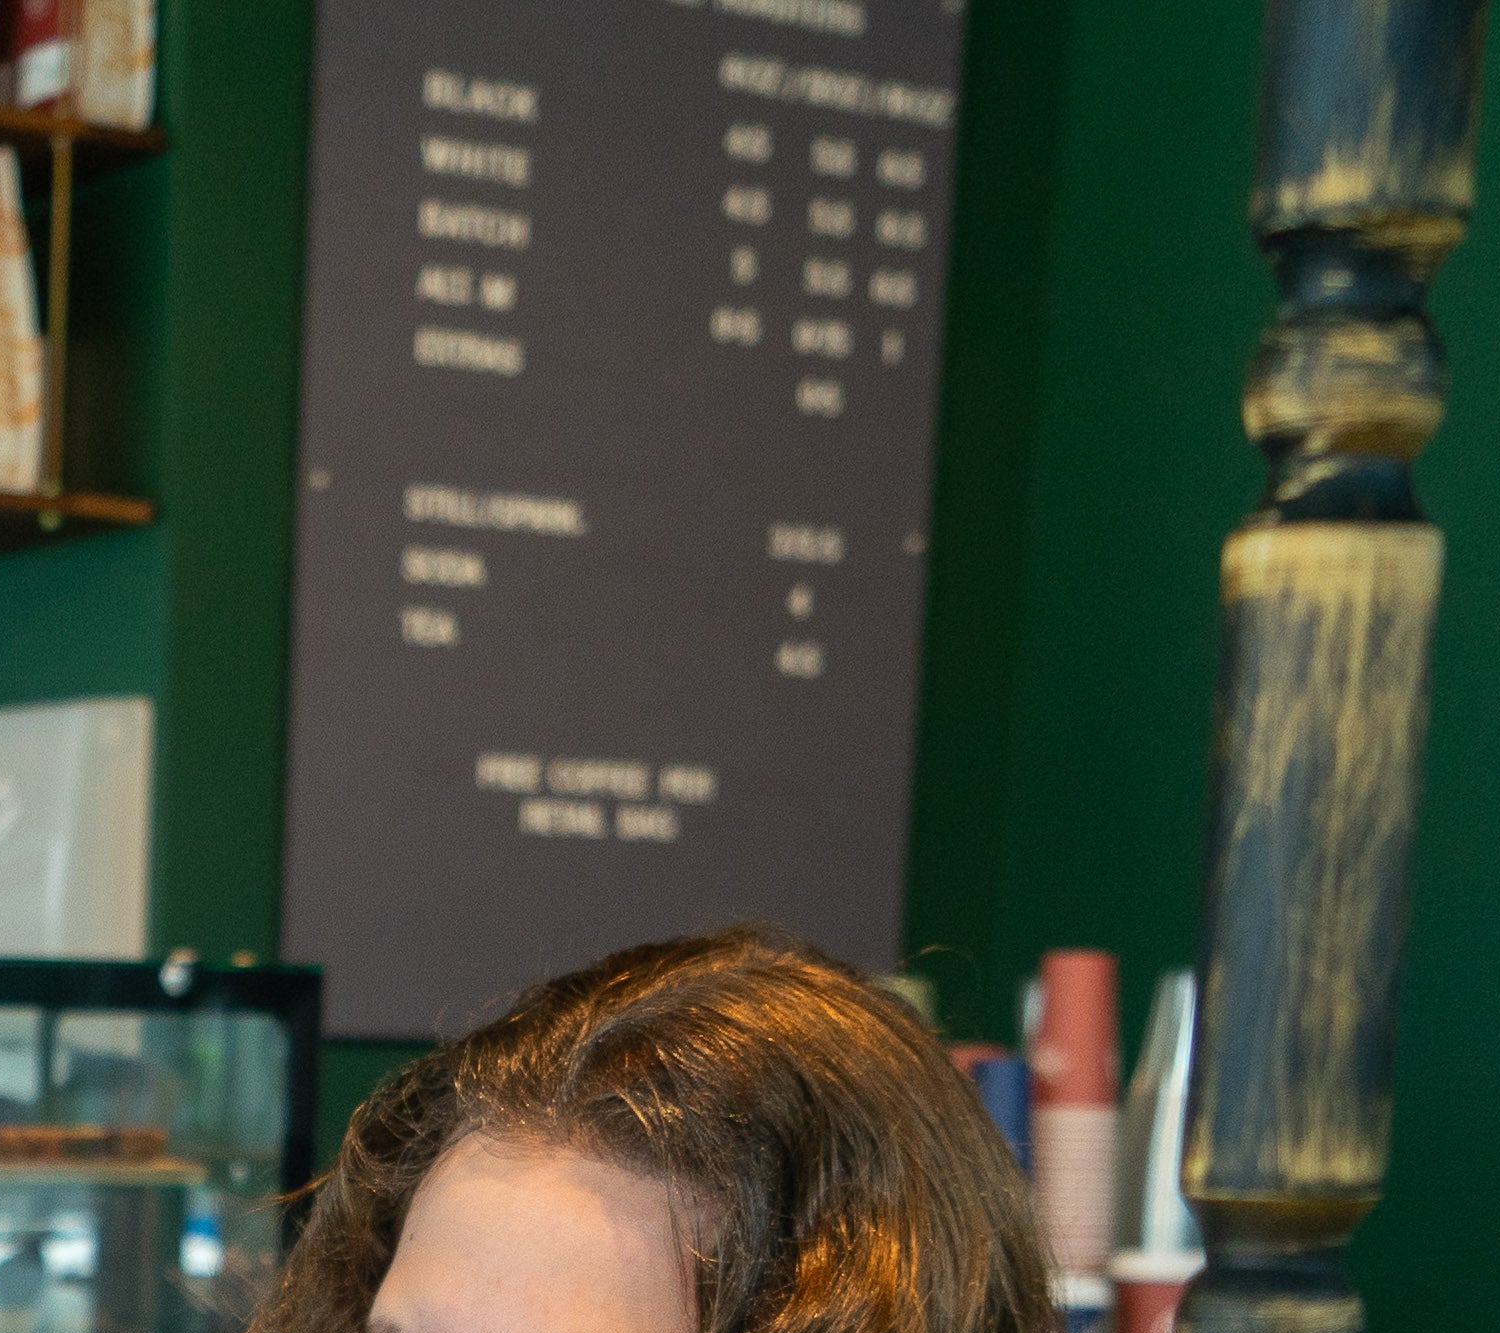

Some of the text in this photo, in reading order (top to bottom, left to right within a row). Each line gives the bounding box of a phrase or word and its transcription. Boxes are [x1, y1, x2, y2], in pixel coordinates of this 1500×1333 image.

[423, 70, 537, 121] BLACK
[420, 136, 530, 187] WHITE
[399, 605, 461, 647] TEA
[475, 752, 543, 794] FREE
[546, 757, 651, 801] COFFEE
